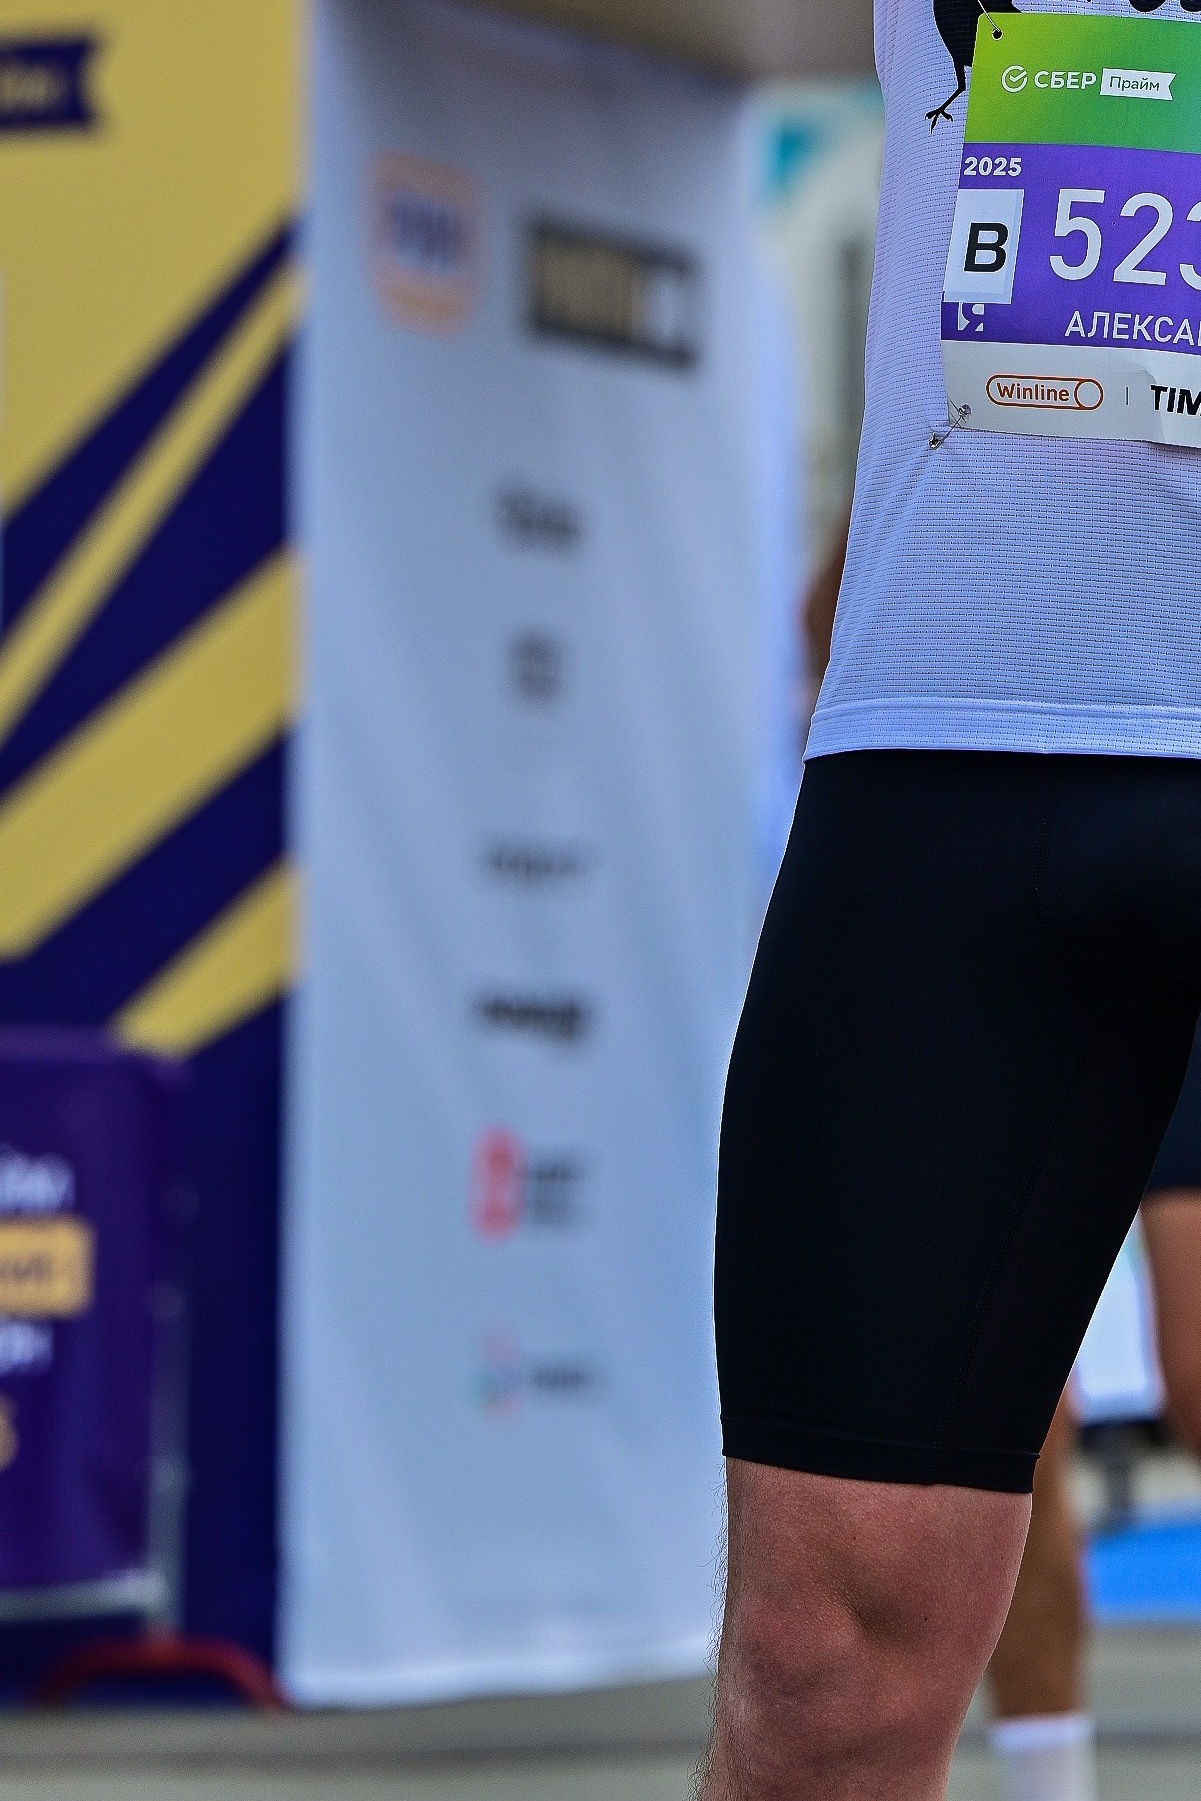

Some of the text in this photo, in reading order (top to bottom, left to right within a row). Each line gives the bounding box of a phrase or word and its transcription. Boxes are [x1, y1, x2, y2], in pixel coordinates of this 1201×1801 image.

[1034, 70, 1161, 92] СБЕР Прайм
[963, 156, 1023, 177] 2025
[997, 381, 1070, 402] Winline
